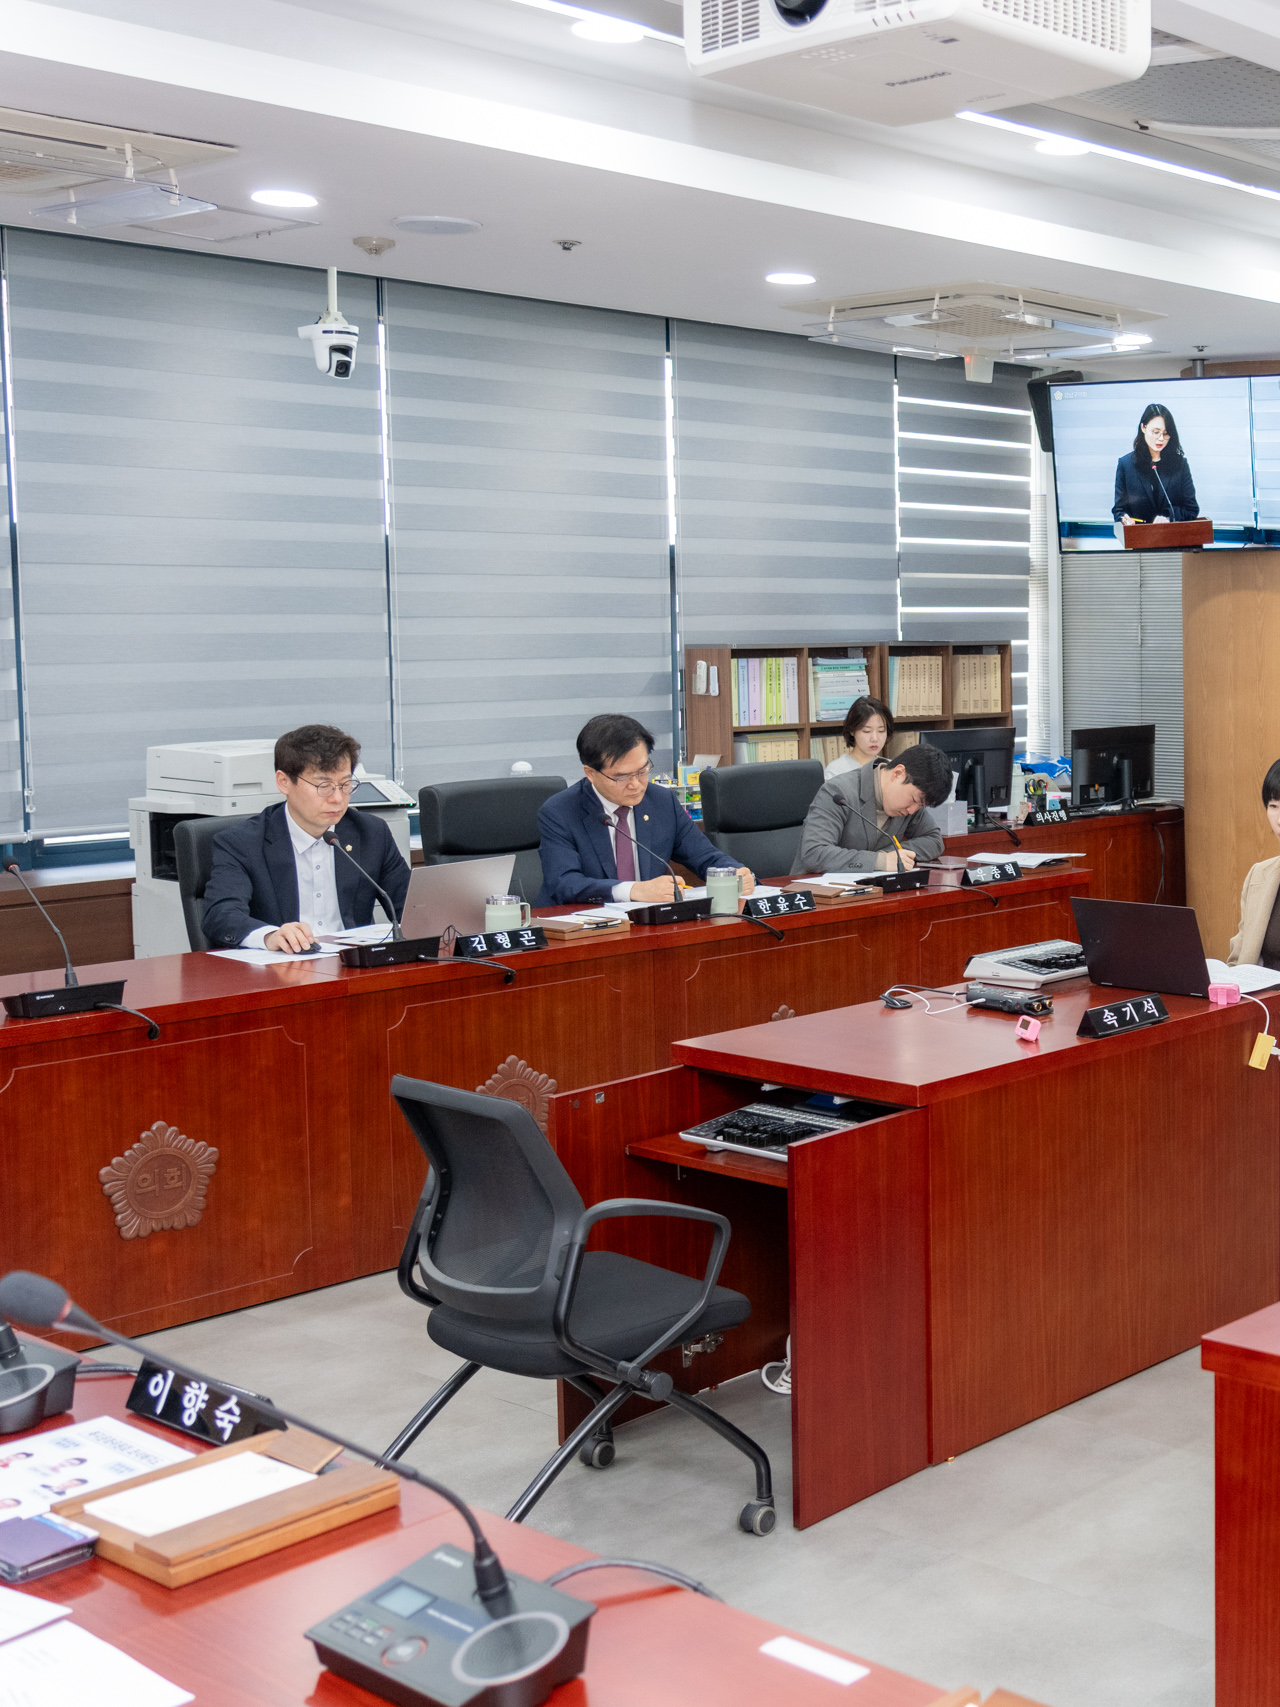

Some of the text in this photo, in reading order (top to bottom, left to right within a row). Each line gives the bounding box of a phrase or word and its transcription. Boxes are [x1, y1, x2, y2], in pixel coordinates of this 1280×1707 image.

[1036, 810, 1068, 823] 의사진행
[976, 863, 1017, 881] 우종혁
[757, 893, 807, 914] 한윤수
[470, 930, 536, 952] 김형곤
[1103, 998, 1159, 1028] 속기석
[136, 1163, 187, 1197] 의회
[147, 1369, 241, 1442] 이향숙
